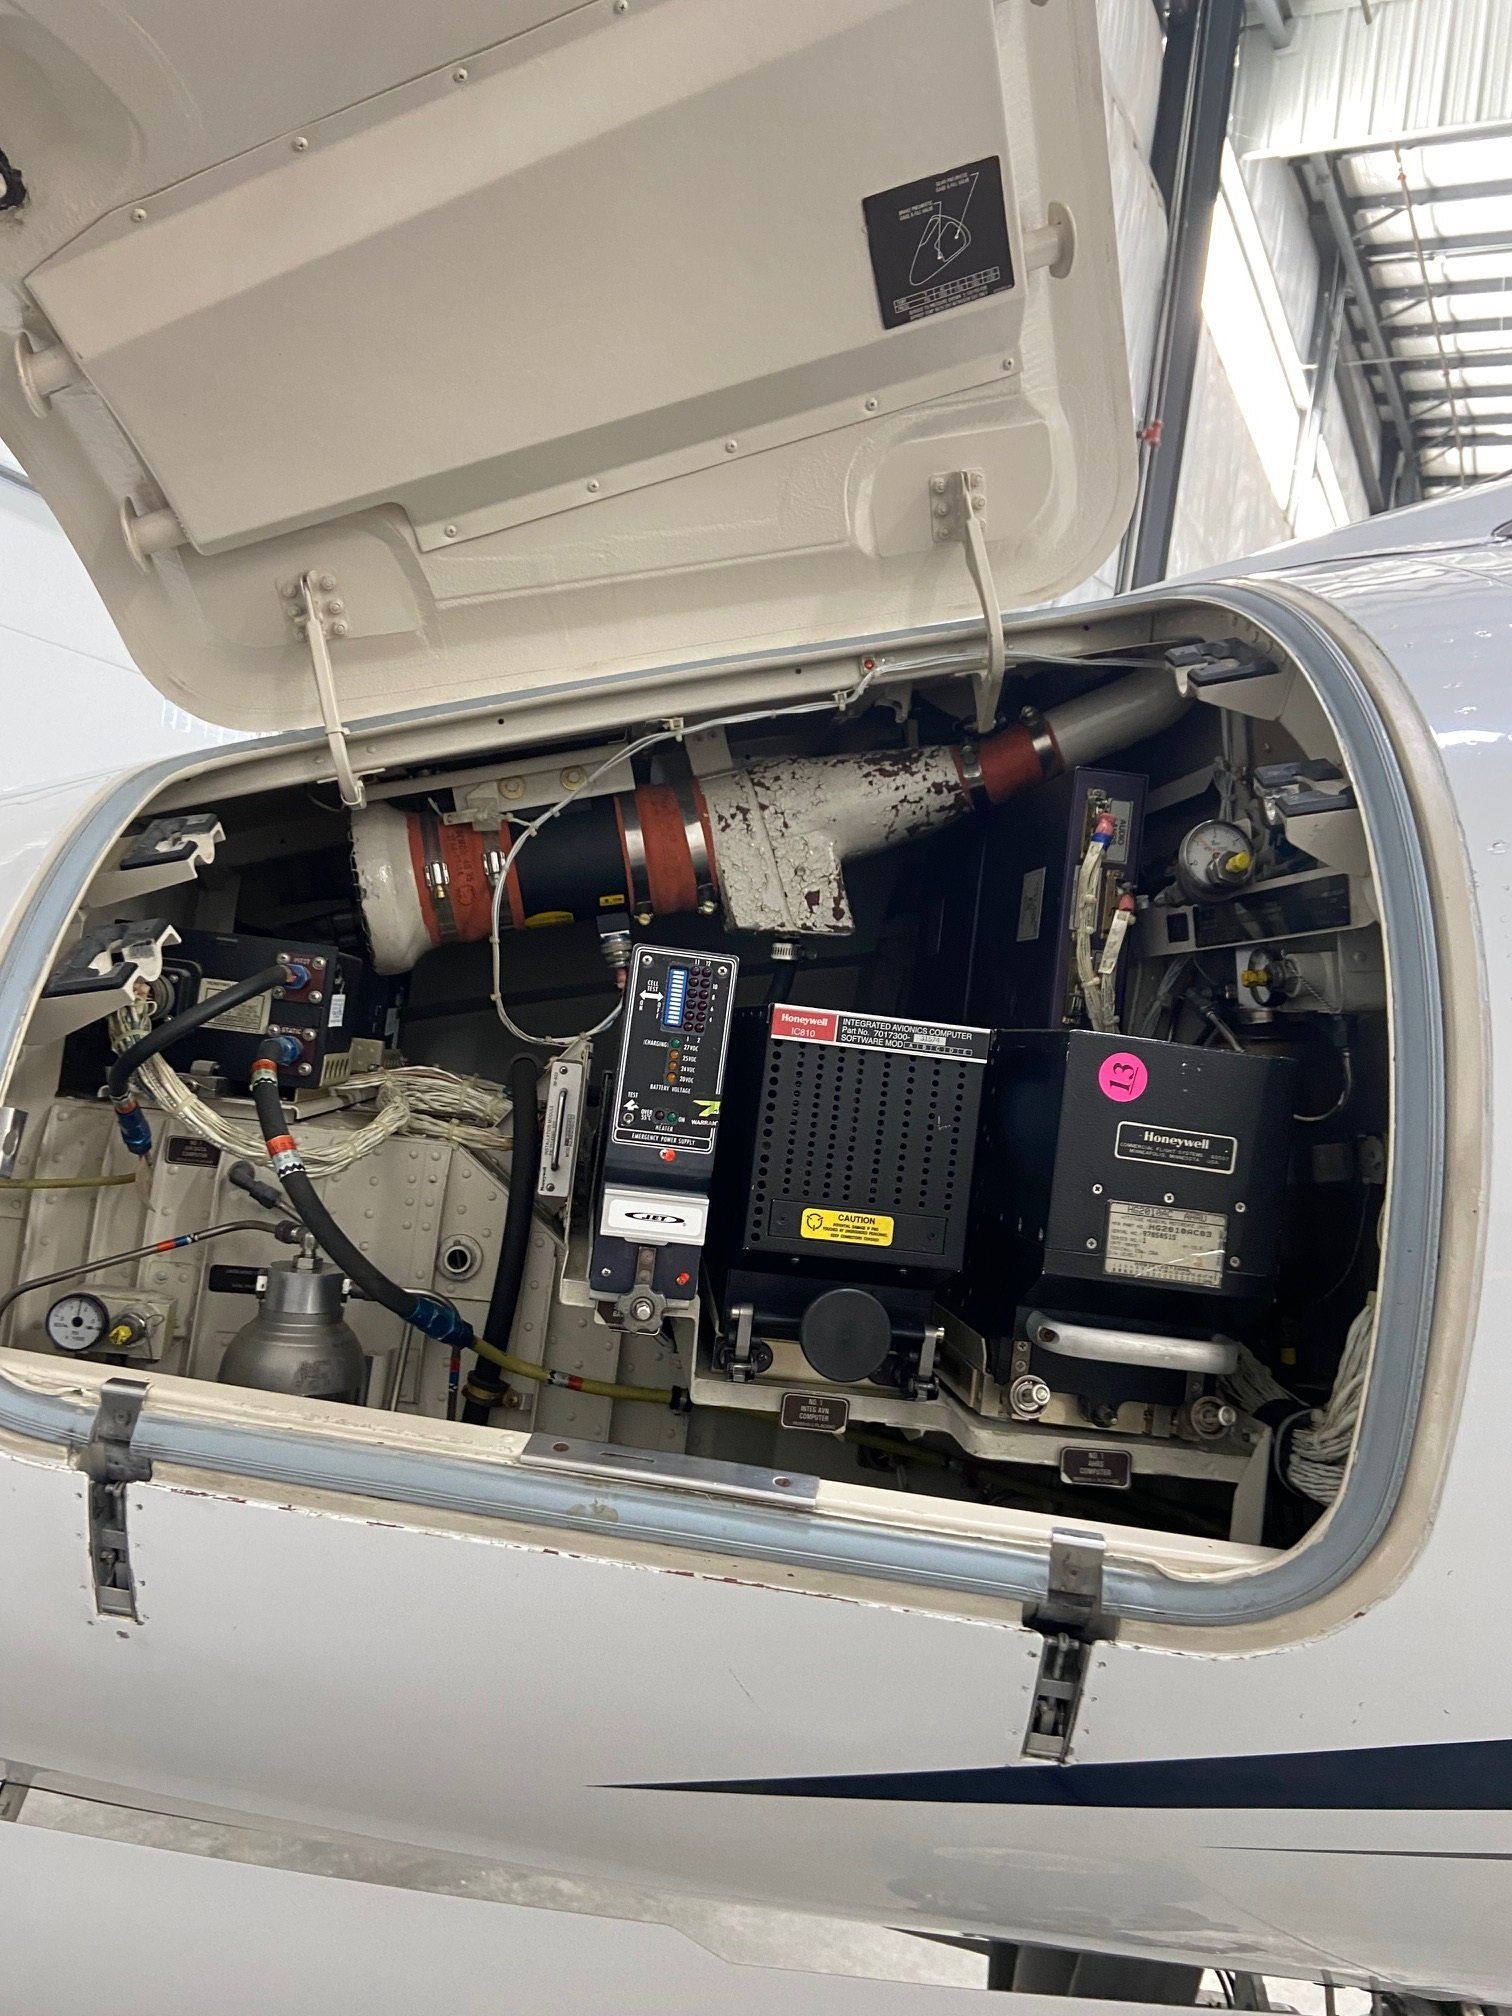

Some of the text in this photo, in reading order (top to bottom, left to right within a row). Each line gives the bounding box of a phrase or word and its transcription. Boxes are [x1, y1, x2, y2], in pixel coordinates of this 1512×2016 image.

[1117, 818, 1127, 846] AUDIO
[647, 979, 659, 987] CELL
[647, 985, 659, 993] TEST
[781, 1013, 828, 1027] Honeywell
[791, 1027, 816, 1038] IC810
[841, 1026, 859, 1036] Part
[861, 1028, 870, 1037] No.
[873, 1028, 911, 1041] 7017300-
[842, 1018, 972, 1041] INTEGRATED AVIONICS COMPUTER
[841, 1033, 904, 1049] SOFTWARE MOD
[1109, 1062, 1135, 1092] 13
[627, 1091, 639, 1099] TEST
[649, 1083, 691, 1095] BATTERY VOLTAGE
[640, 1108, 653, 1116] OVER
[655, 1124, 673, 1132] HEATER
[631, 1132, 696, 1147] EMERGENCY POWER SUPPLY
[1143, 1130, 1210, 1150] Honeywell
[838, 1214, 876, 1225] CAUTION
[799, 1412, 829, 1422] COMPUTER
